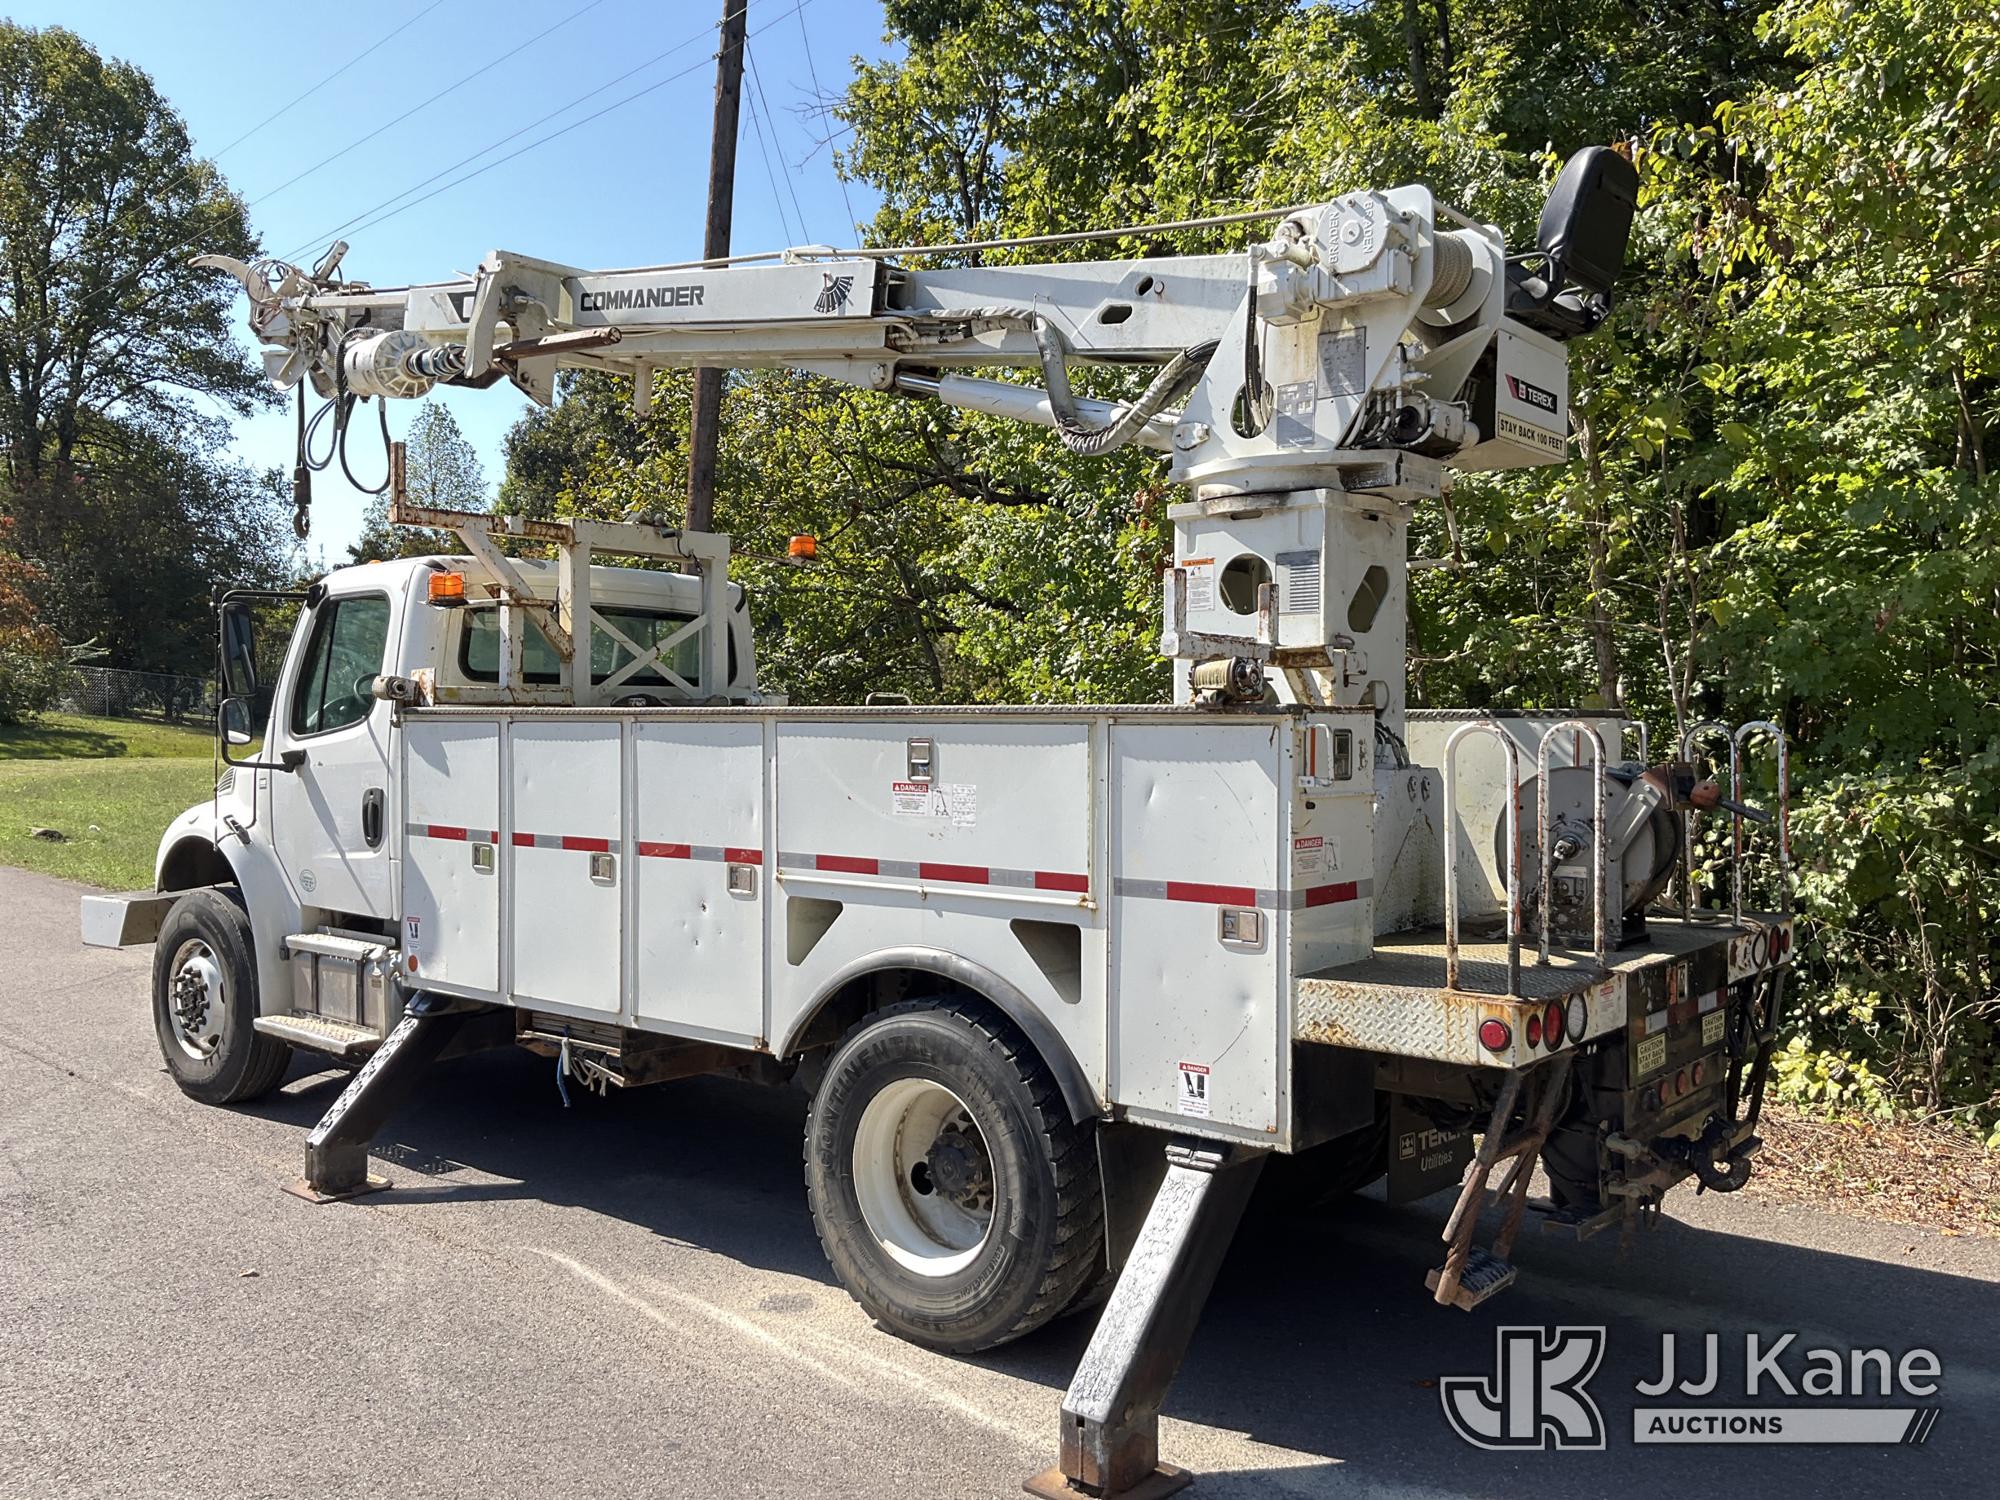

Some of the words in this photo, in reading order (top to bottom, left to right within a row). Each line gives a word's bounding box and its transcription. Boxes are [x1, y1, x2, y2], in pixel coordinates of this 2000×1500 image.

[1329, 211, 1340, 264] BRADEN
[1364, 200, 1374, 254] BRADEN
[580, 285, 704, 312] COMMANDER
[1527, 387, 1553, 409] TEREX
[1500, 419, 1517, 433] STAY
[1518, 424, 1535, 442] BACK
[1536, 432, 1548, 445] 100
[1548, 436, 1563, 451] FEET
[900, 784, 927, 792] DANGER
[1639, 1039, 1663, 1055] CAUTION
[1639, 1053, 1650, 1064] STAY
[1651, 1048, 1664, 1058] BACK
[1650, 1055, 1662, 1065] FEET
[1418, 1128, 1461, 1150] TER
